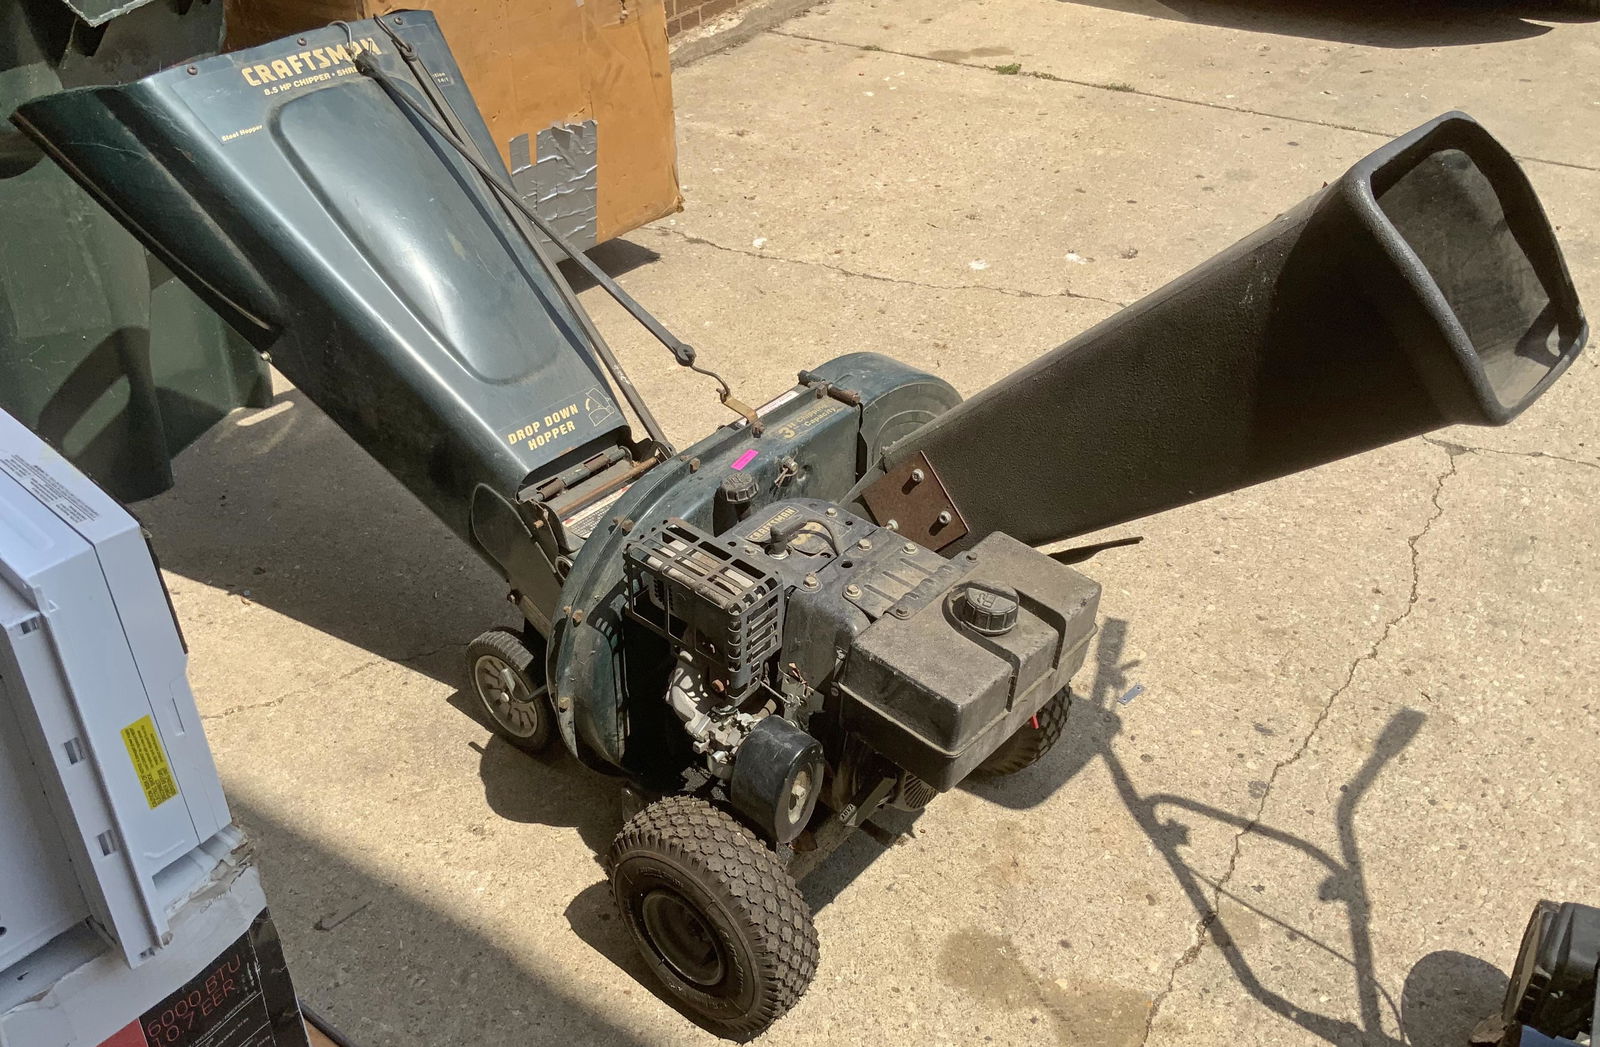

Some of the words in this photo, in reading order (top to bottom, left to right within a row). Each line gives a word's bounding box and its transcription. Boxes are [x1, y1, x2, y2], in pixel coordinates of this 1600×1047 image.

[241, 37, 382, 87] CRAFTSMAN
[264, 85, 279, 96] 8.5
[279, 81, 292, 92] HP
[293, 72, 331, 89] CHIPPER
[239, 124, 263, 137] Hopper
[507, 421, 541, 445] DROP
[543, 403, 579, 427] DOWN
[527, 420, 576, 451] HOPPER
[147, 990, 201, 1038] 6000
[204, 954, 241, 994] BTU
[201, 978, 239, 1016] EER
